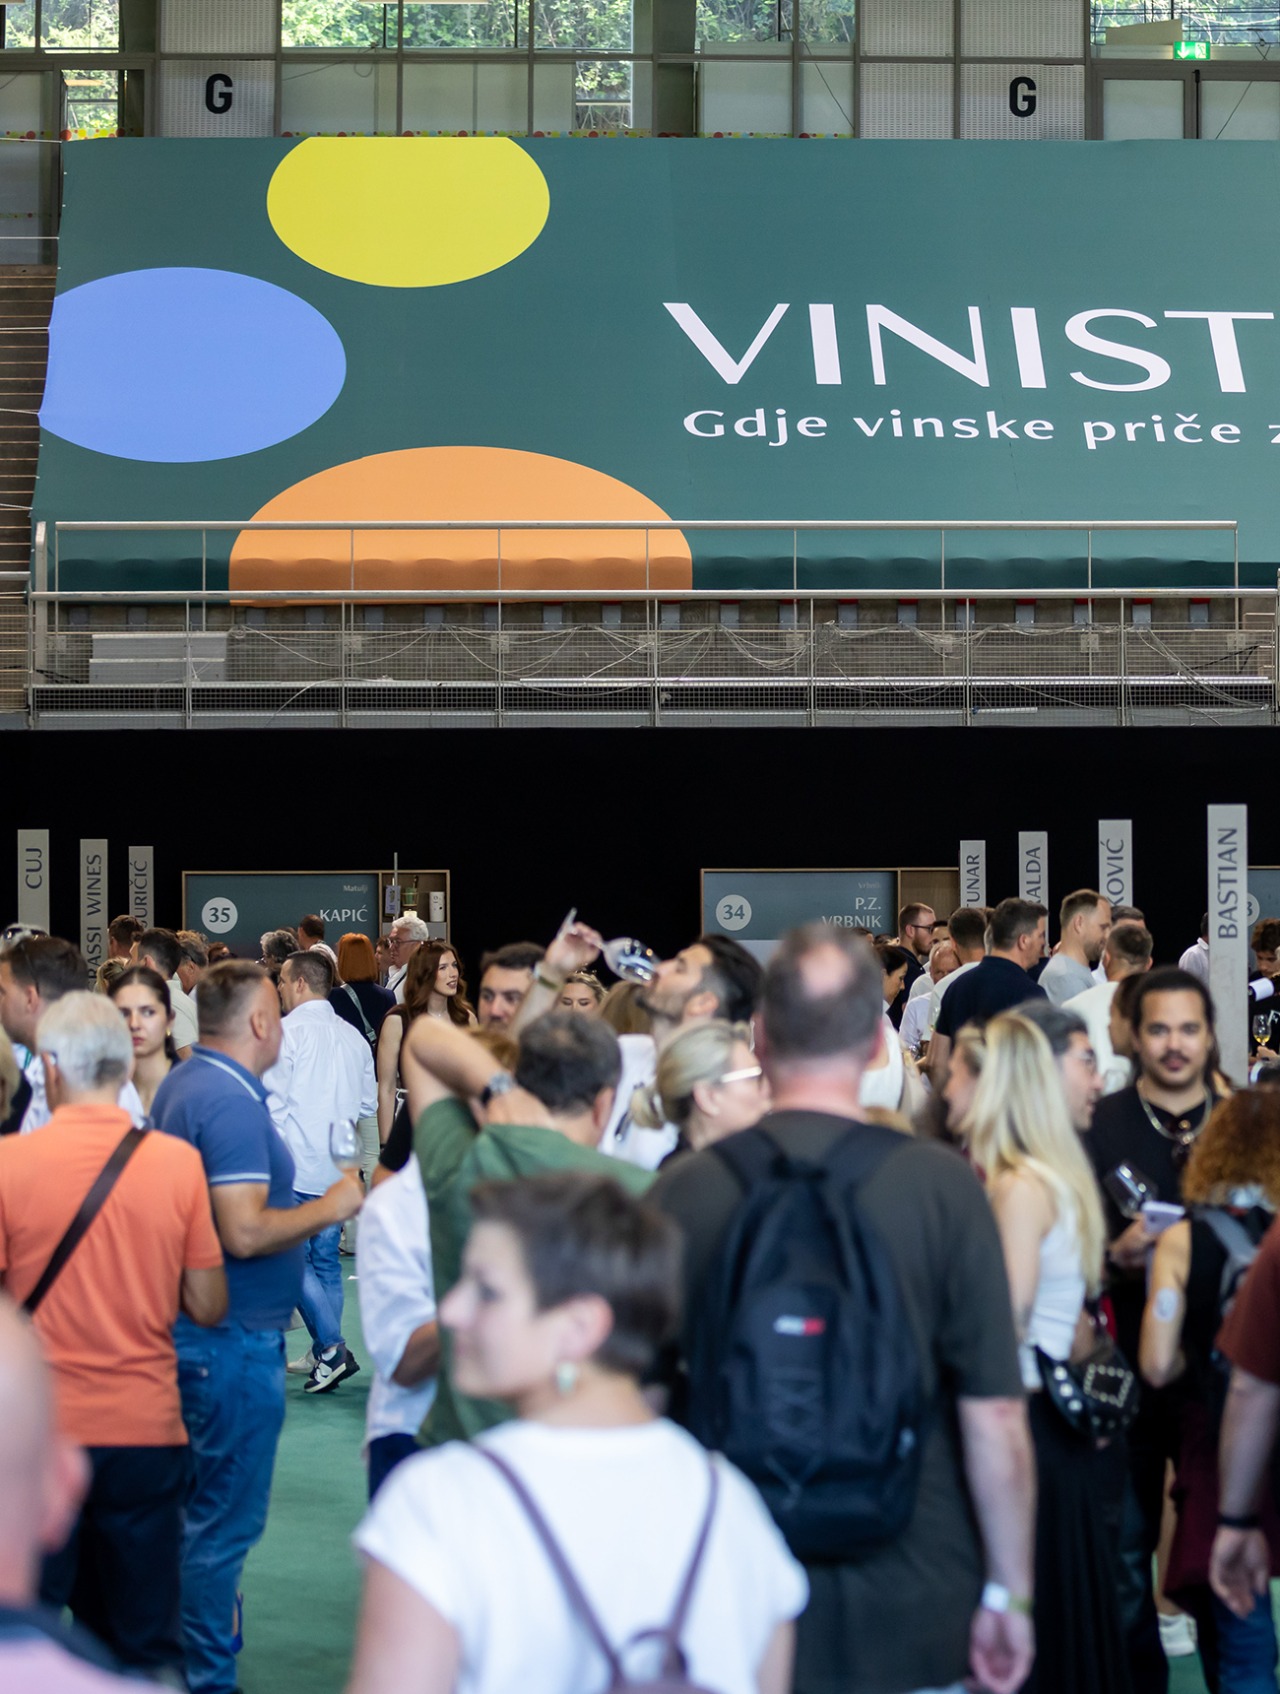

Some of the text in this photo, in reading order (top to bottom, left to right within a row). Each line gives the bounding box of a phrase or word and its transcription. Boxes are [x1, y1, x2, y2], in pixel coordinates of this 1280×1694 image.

[205, 73, 233, 114] G
[1009, 76, 1036, 117] G
[683, 408, 827, 446] Gdje
[853, 409, 1054, 439] vinske
[1083, 413, 1241, 450] priče
[25, 848, 42, 889] CUJ
[86, 854, 102, 916] WINES
[966, 854, 981, 907] UNAR
[1026, 847, 1041, 903] ALDA
[1100, 838, 1125, 906] KOVIĆ
[1217, 828, 1239, 939] BASTIAN
[209, 907, 231, 923] 35
[319, 904, 368, 922] KAPIĆ
[723, 904, 745, 920] 34
[855, 897, 882, 910] P.Z.
